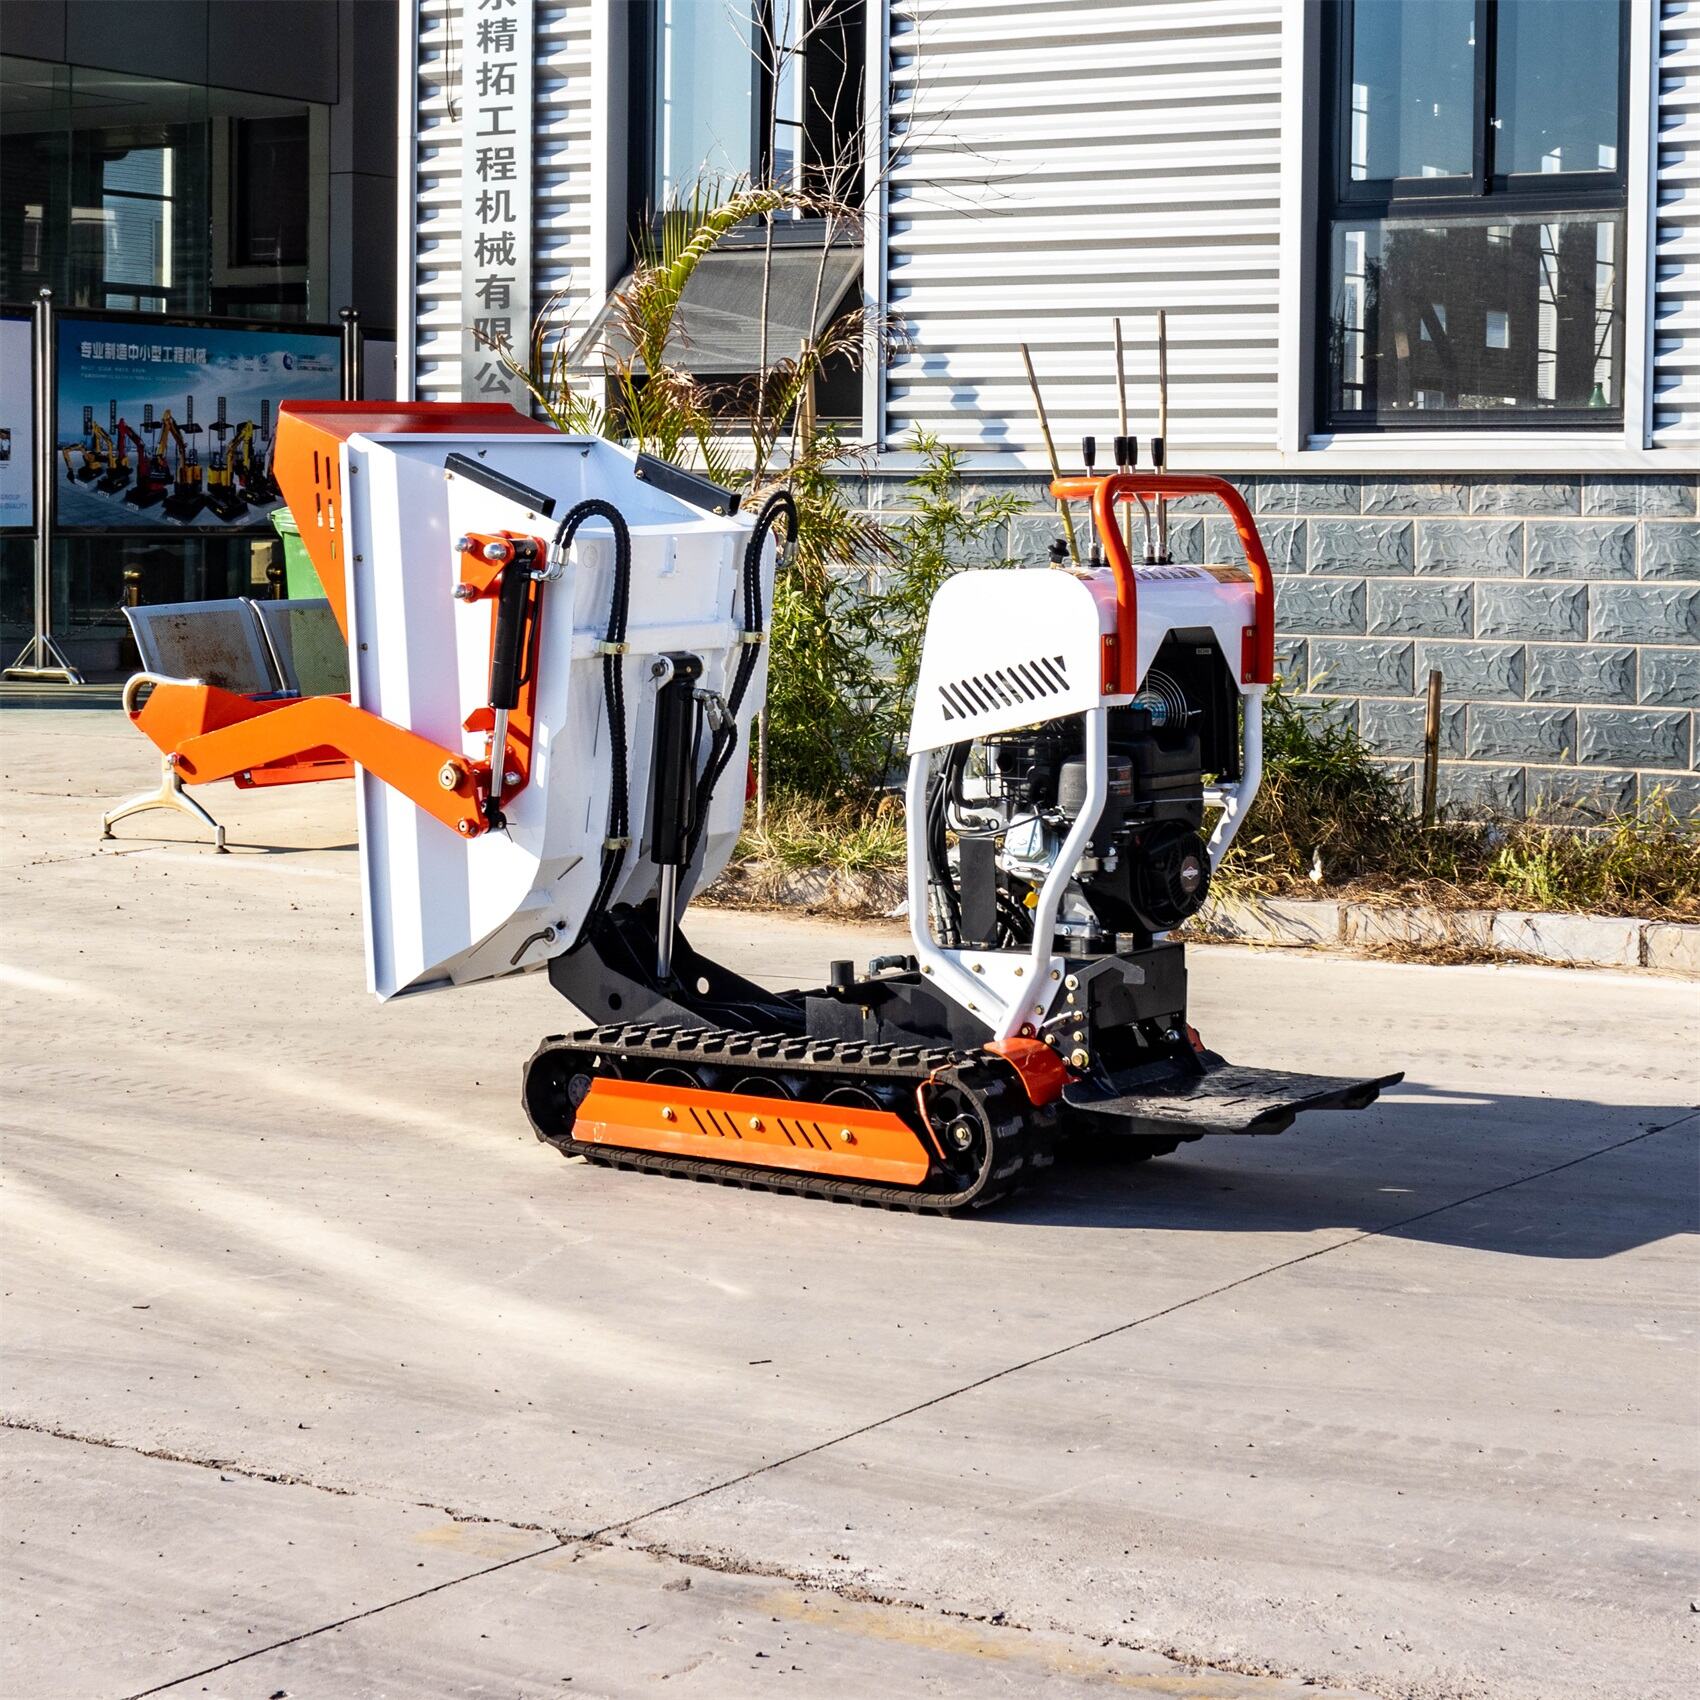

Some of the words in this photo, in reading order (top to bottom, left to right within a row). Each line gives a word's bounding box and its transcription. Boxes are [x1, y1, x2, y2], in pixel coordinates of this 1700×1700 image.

[474, 0, 518, 394] 精拓工程机械有限公
[80, 341, 207, 365] 专业制造中小型工程机械
